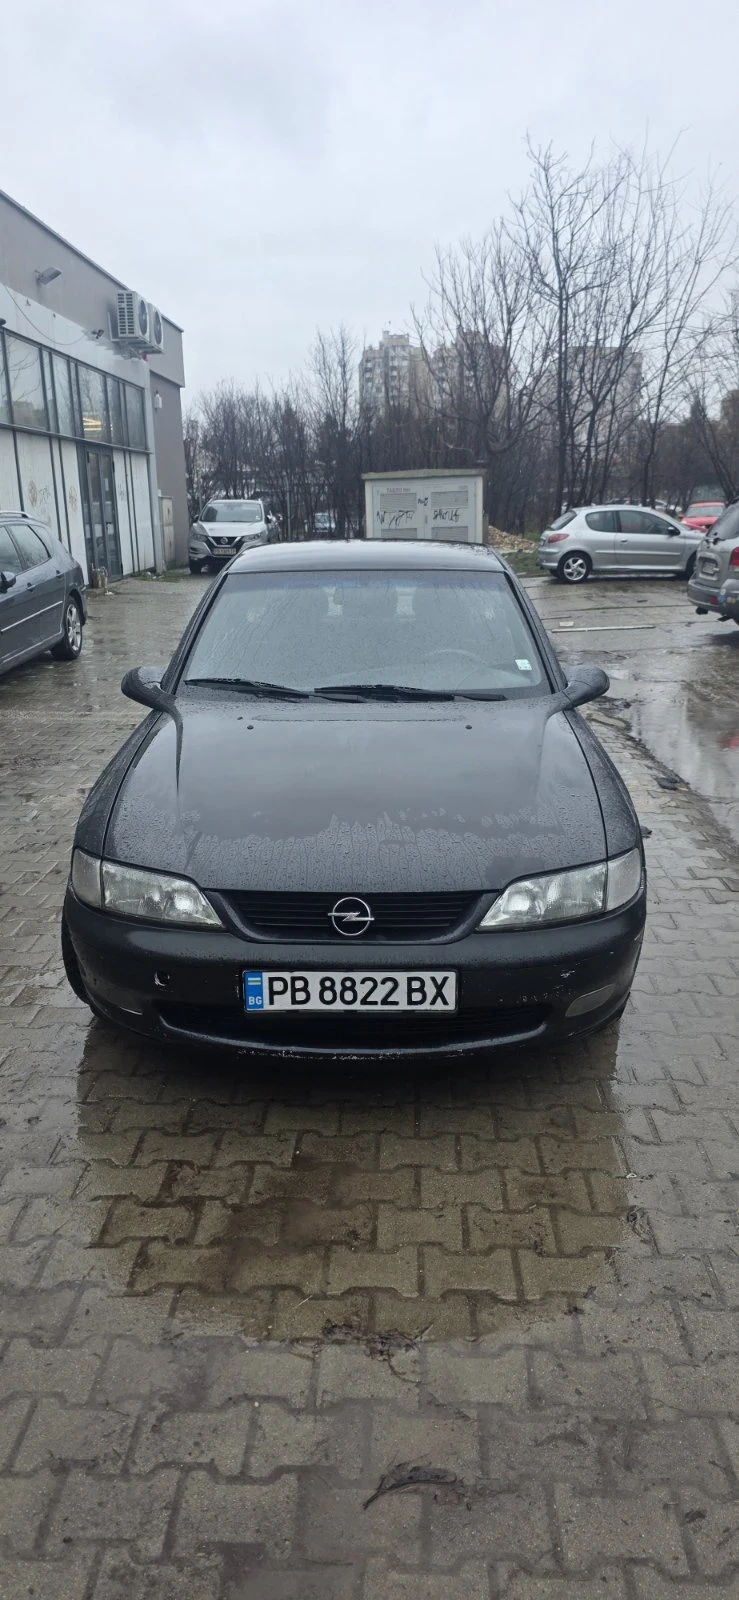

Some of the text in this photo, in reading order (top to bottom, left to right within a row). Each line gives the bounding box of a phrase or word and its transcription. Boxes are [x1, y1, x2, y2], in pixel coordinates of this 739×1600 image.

[248, 996, 263, 1006] BG
[268, 976, 449, 1006] PB 8822 BX
